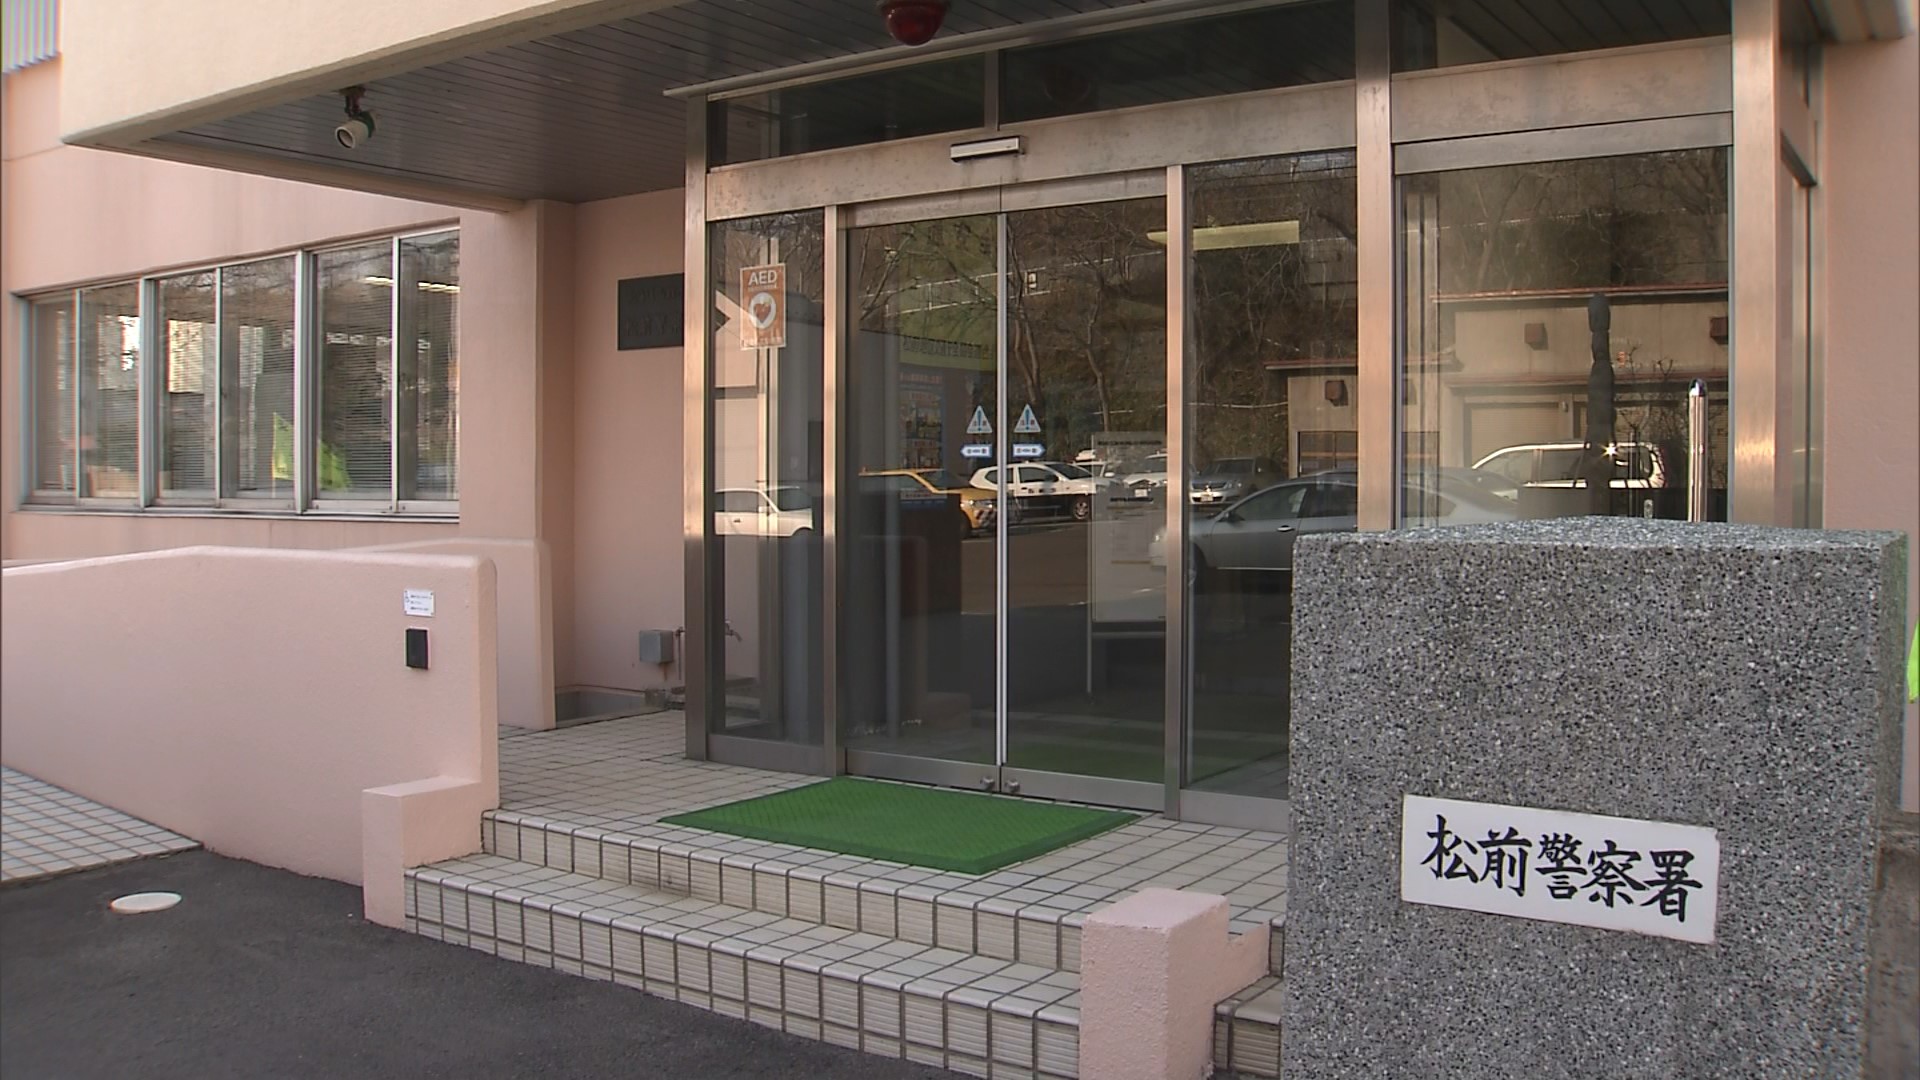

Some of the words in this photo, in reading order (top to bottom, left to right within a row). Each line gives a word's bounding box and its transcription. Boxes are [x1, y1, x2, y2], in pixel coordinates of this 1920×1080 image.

[748, 269, 777, 286] AED
[1421, 814, 1702, 923] 松前警察署
